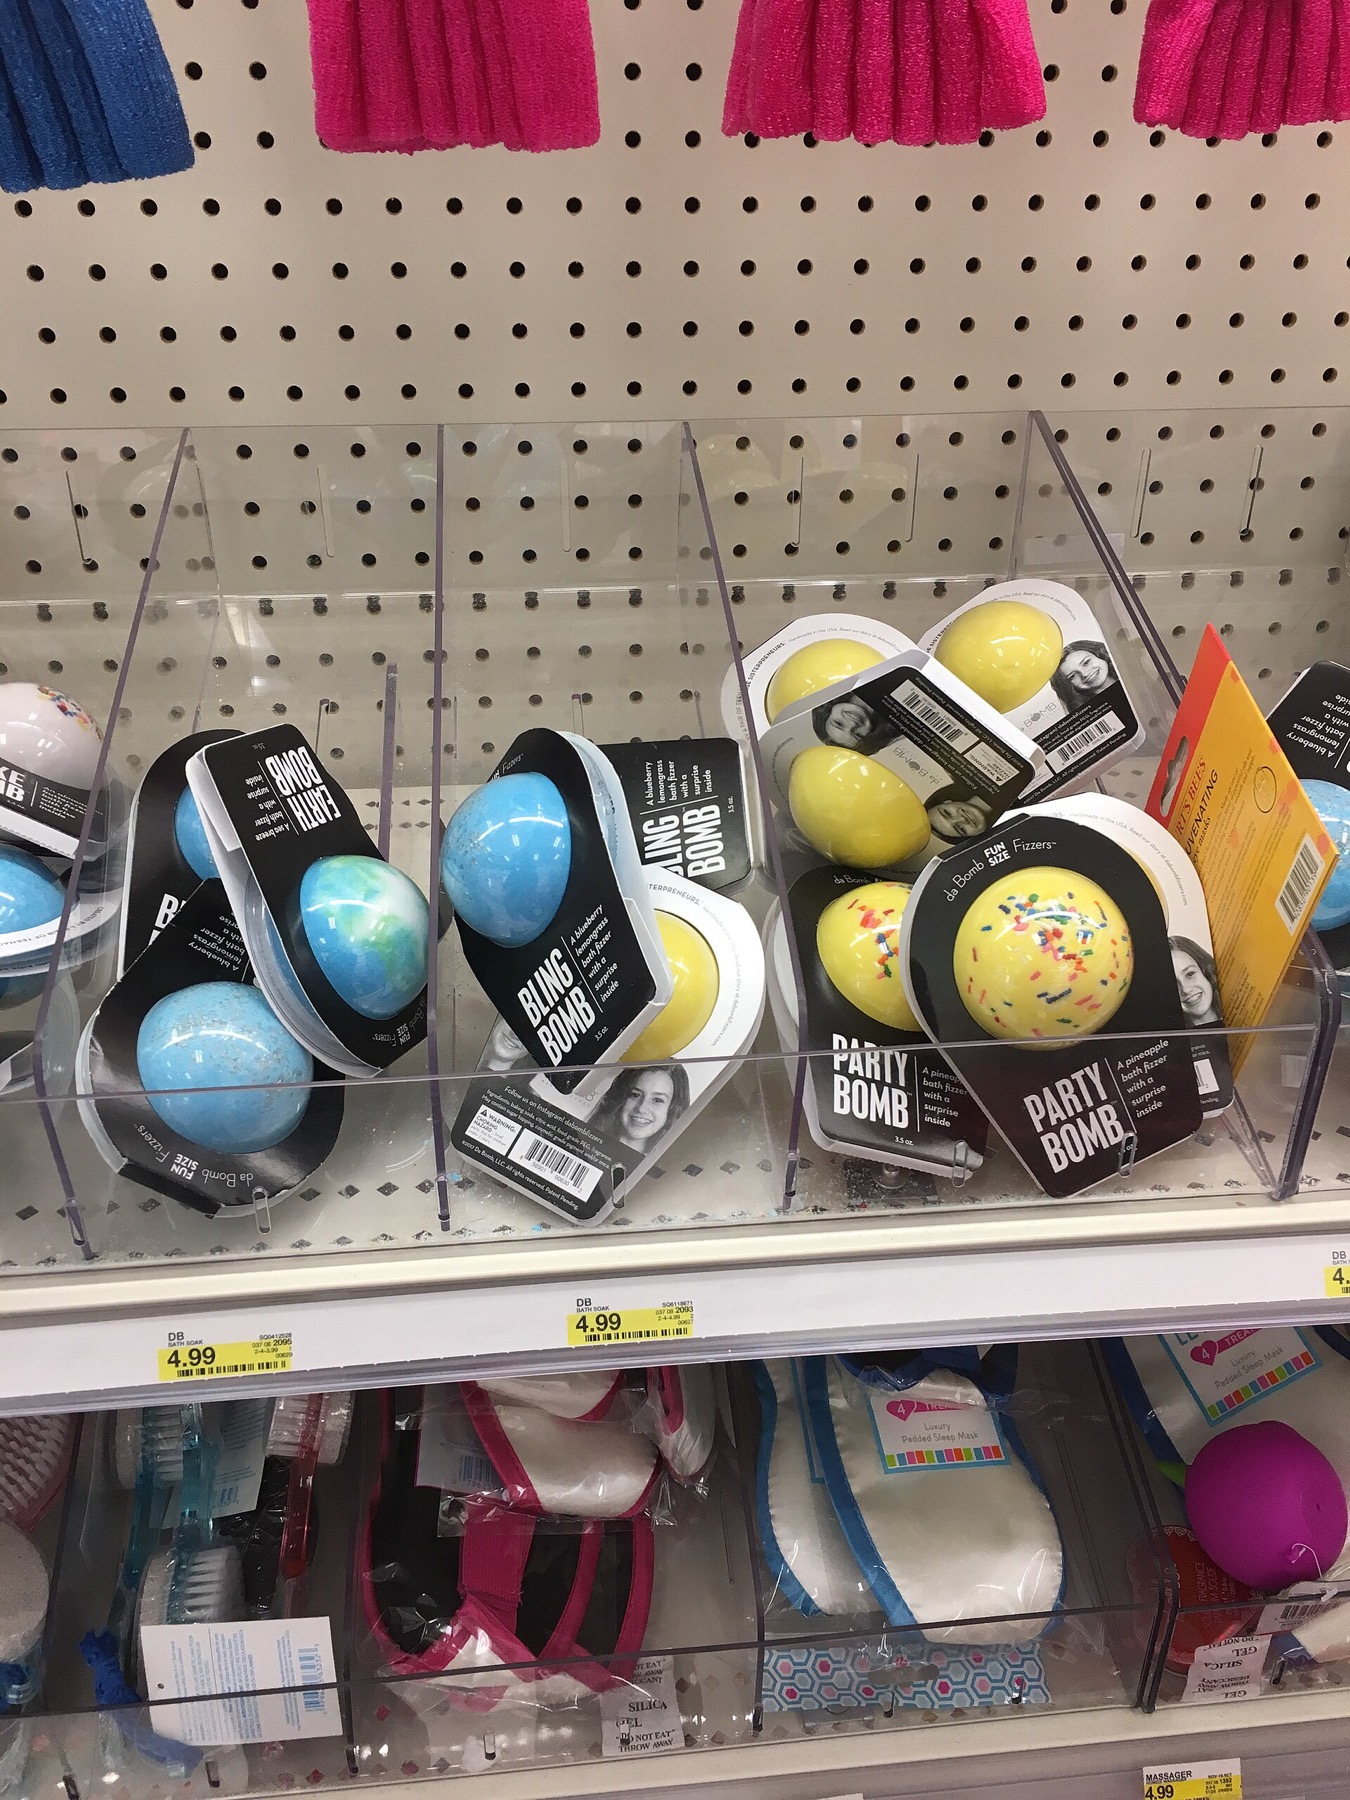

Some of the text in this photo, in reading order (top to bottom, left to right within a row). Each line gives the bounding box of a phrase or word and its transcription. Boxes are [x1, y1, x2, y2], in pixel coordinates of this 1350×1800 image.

[1322, 700, 1350, 717] urprise
[1301, 715, 1346, 740] bath fizzer
[1331, 716, 1350, 728] with
[1286, 731, 1336, 758] A blueberry
[1293, 723, 1340, 750] lemongrass
[265, 745, 324, 796] BOMB
[643, 761, 654, 799] blueberry
[690, 764, 702, 796] surprise
[244, 774, 264, 788] inside
[656, 759, 666, 804] lemongrass
[667, 760, 678, 801] bath fizzer
[679, 781, 689, 799] with
[702, 769, 713, 793] inside
[246, 786, 270, 800] surprise
[263, 799, 277, 811] with
[286, 784, 342, 832] EARTH
[727, 804, 735, 814] 3.5
[1184, 768, 1219, 856] UVENATING
[254, 810, 285, 827] bath fizzer
[284, 822, 290, 832] A
[254, 827, 277, 841] breeze
[682, 804, 726, 878] BOMB
[1129, 827, 1143, 838] Read
[1149, 842, 1162, 855] story
[983, 841, 1006, 859] FUN
[987, 850, 1012, 867] SIZE
[833, 874, 845, 885] da
[942, 858, 985, 902] da Bomb
[648, 883, 701, 906] TERPRENEURS.
[222, 927, 230, 935] a
[569, 903, 604, 946] A blueberry
[200, 927, 246, 956] bath fizzer
[575, 916, 609, 957] lemongrass
[188, 941, 240, 972] A blueberry
[193, 933, 242, 965] lemongrass
[580, 929, 612, 969] bath fizzer
[587, 956, 608, 980] with a
[594, 961, 619, 992] surprise
[517, 947, 574, 1029] BLING
[600, 979, 620, 1003] inside
[536, 985, 596, 1068] BOMB
[594, 1029, 604, 1043] 3.5
[832, 1032, 908, 1087] PARTY
[1116, 1038, 1169, 1071] A pineapple
[921, 1066, 929, 1075] A
[1120, 1054, 1169, 1083] bath fizzer
[922, 1078, 969, 1096] bath fizzer
[1126, 1076, 1155, 1094] with a
[504, 1085, 523, 1098] Follow
[528, 1099, 537, 1107] on
[536, 1103, 566, 1123] Instagram!
[833, 1073, 909, 1129] BOMB
[923, 1091, 943, 1101] with
[1023, 1061, 1108, 1134] PARTY
[1131, 1084, 1167, 1107] surprise
[923, 1102, 959, 1118] surprise
[1135, 1100, 1164, 1119] inside
[473, 1119, 493, 1134] HAZARD
[488, 1112, 517, 1134] WARNING:
[924, 1114, 951, 1128] inside
[1040, 1103, 1125, 1174] BOMB
[174, 1153, 199, 1171] SIZE
[170, 1163, 195, 1181] FUN
[201, 1168, 254, 1188] da Bomb
[1332, 1250, 1347, 1260] DB
[576, 1297, 592, 1307] DB
[575, 1312, 622, 1334] 4.99
[675, 1305, 694, 1314] 2093
[657, 1314, 681, 1322] 2-4-4.99
[167, 1331, 185, 1341] DB
[1201, 1347, 1210, 1359] 4
[1224, 1328, 1255, 1347] TREA
[167, 1346, 216, 1368] 4.99
[272, 1338, 293, 1347] 2095
[1230, 1349, 1256, 1367] Luxury
[1214, 1347, 1284, 1390] Padded Sleep Mask
[897, 1403, 906, 1415] 4
[923, 1422, 952, 1431] Luxury
[901, 1431, 979, 1443] Padded Sleep Mask
[1222, 1636, 1240, 1647] NOT
[1231, 1645, 1258, 1658] GEL
[1203, 1659, 1243, 1671] SILICA
[628, 1700, 668, 1713] SILICA
[617, 1738, 674, 1753] THROW AWAY
[635, 1732, 654, 1742] NOT
[1145, 1770, 1193, 1782] MASSAGER
[1144, 1784, 1175, 1800] 4.99
